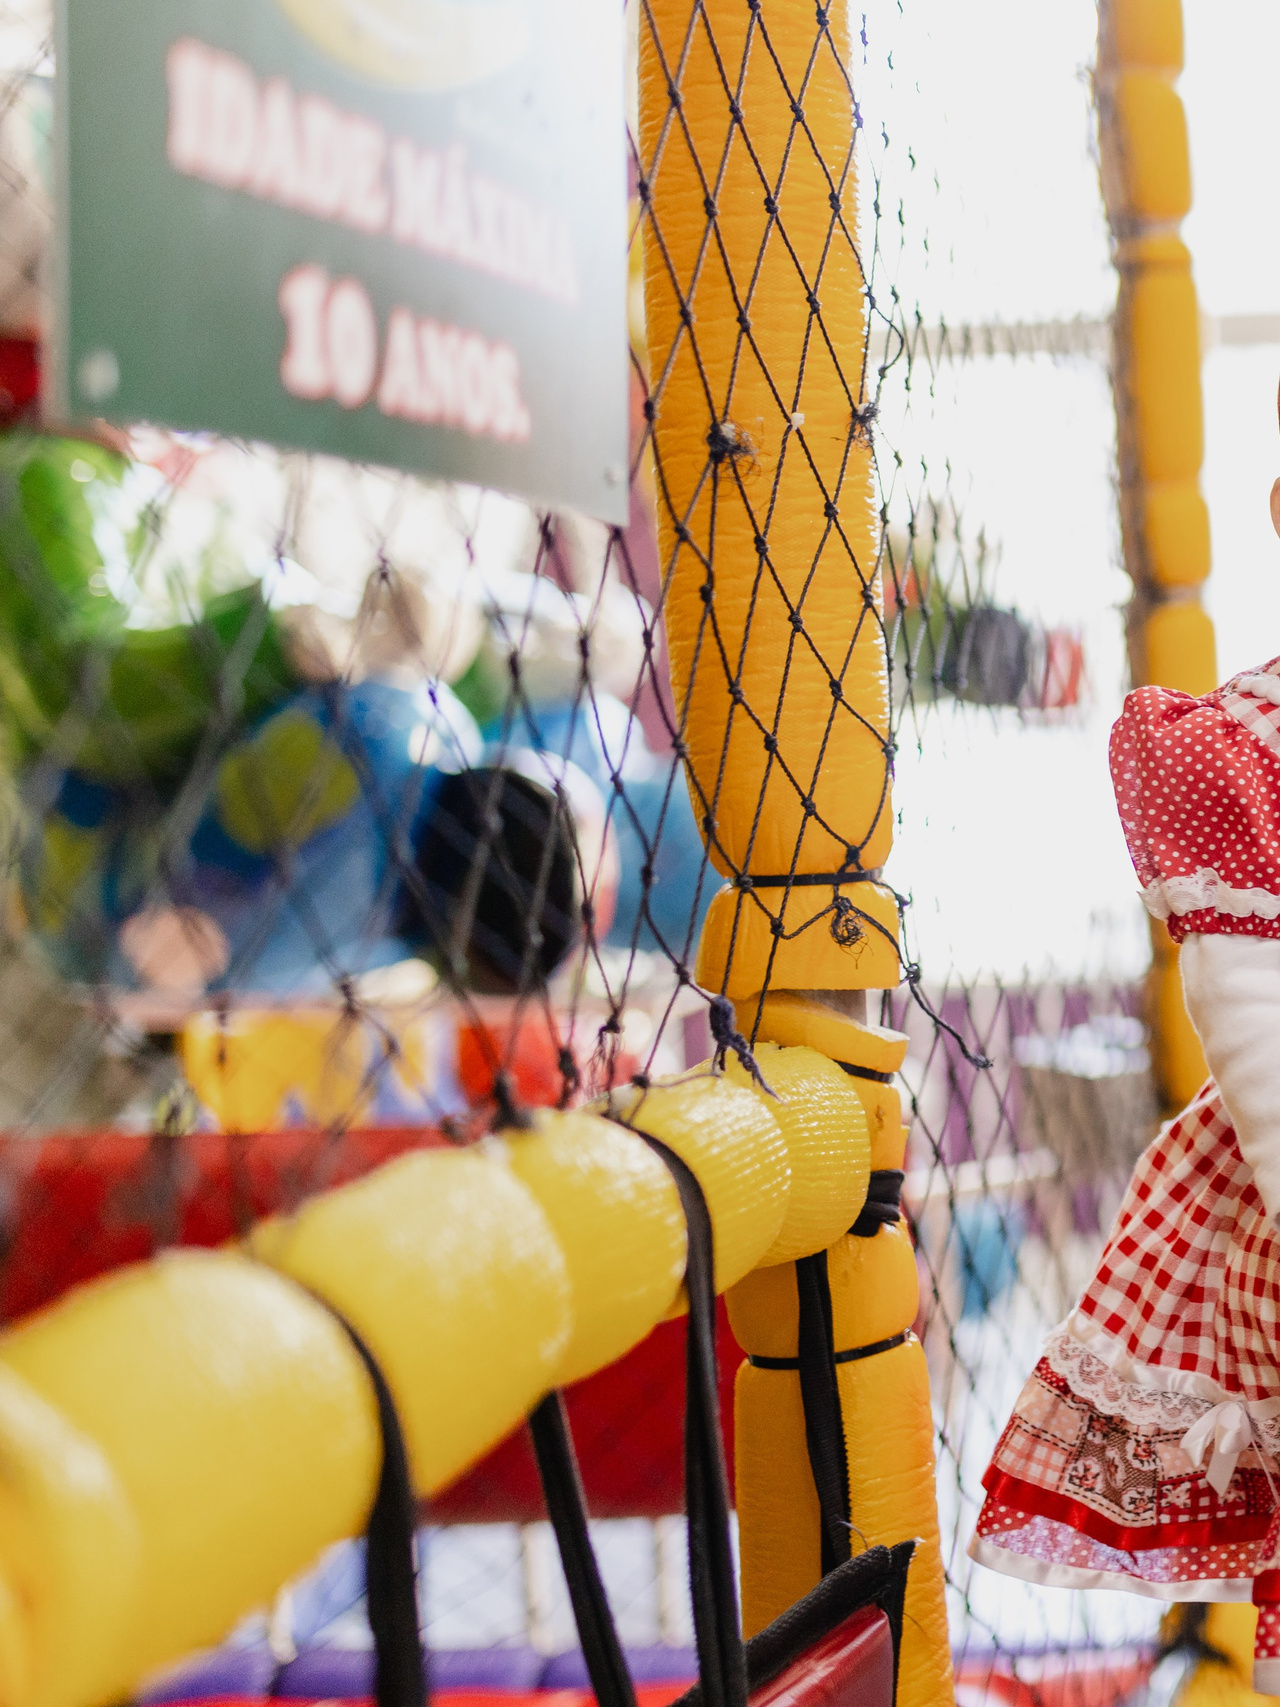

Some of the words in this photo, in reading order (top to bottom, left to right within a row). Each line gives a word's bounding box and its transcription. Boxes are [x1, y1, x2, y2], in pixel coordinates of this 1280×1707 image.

[167, 38, 388, 233] IDADE
[391, 138, 579, 304] MÁXIMA
[280, 263, 377, 408] 10
